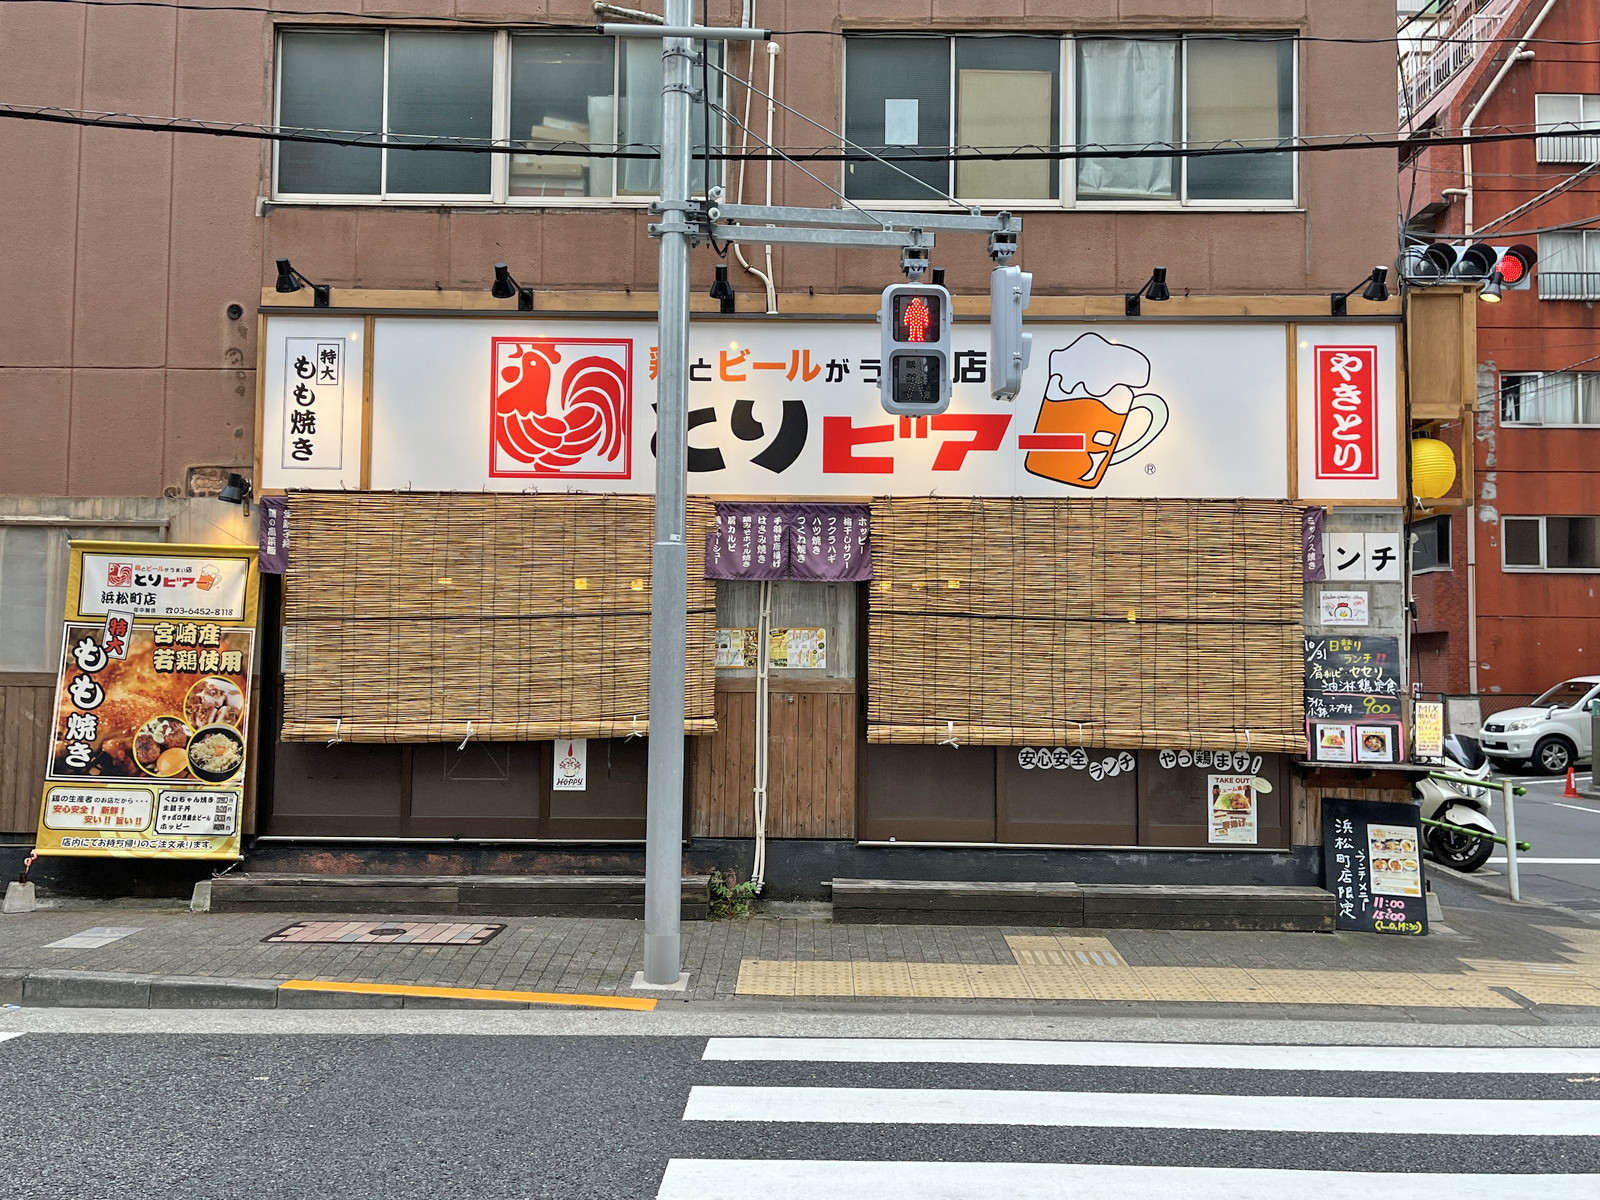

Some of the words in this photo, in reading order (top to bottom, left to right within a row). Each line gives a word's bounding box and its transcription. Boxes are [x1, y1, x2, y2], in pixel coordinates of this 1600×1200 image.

[319, 348, 337, 381] 特大
[290, 354, 317, 462] もも焼き
[1328, 352, 1364, 472] やきとり
[756, 515, 768, 564] はさみ焼き
[796, 516, 807, 564] つくね焼き
[811, 516, 822, 555] ハツ焼き
[827, 516, 837, 564] フクラハギ
[843, 517, 853, 569] 梅干しサワー
[1307, 516, 1317, 570] ミックス焼き
[101, 591, 158, 606] 浜松町店
[105, 617, 129, 656] 特大
[153, 621, 222, 647] 宮崎産
[1329, 639, 1363, 652] 日替り
[153, 649, 243, 675] 若鶏使用
[1343, 653, 1372, 665] ランチ
[64, 636, 109, 769] もも焼き
[1363, 696, 1391, 715] 900
[1334, 818, 1356, 920] 浜松町店限定
[1373, 896, 1406, 910] 11:00
